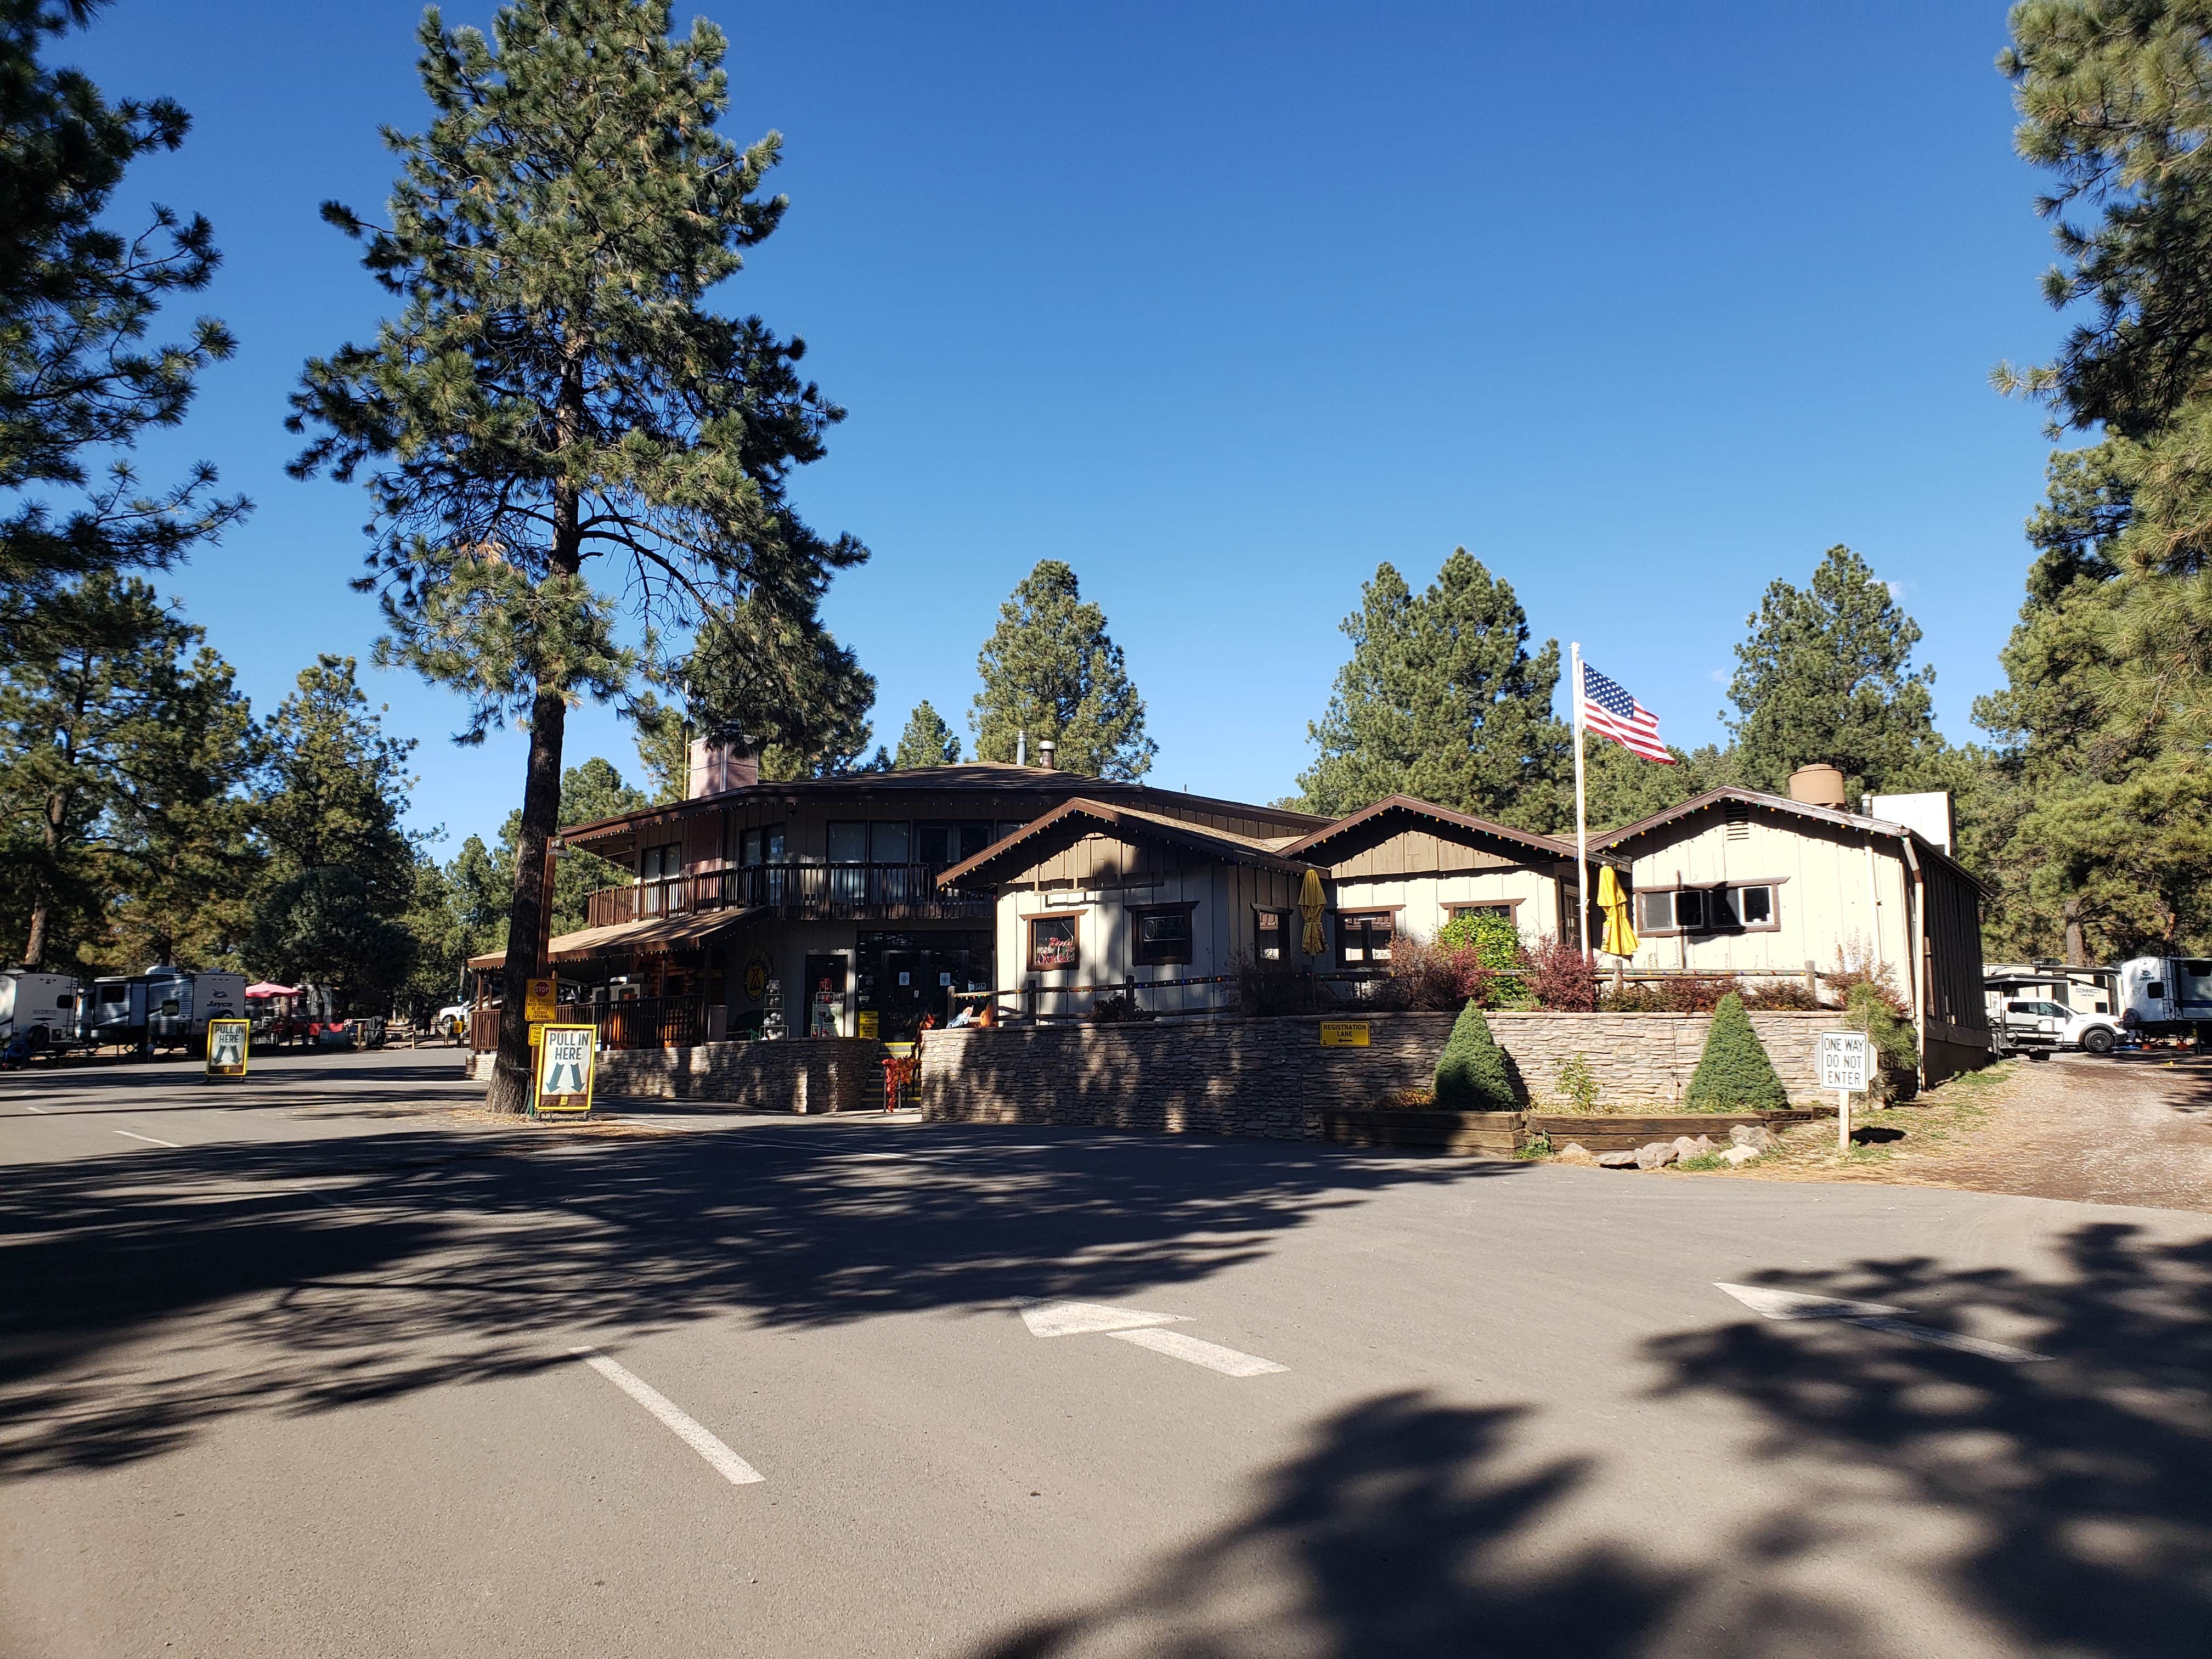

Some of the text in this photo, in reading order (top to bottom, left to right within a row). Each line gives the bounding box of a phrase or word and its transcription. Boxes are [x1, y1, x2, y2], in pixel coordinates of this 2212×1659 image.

[215, 1025, 244, 1034] PULL IN
[219, 1034, 239, 1043] HERE
[549, 1033, 589, 1046] PULL IN
[1824, 1038, 1864, 1052] ONE WAY
[555, 1047, 582, 1060] HERE
[1827, 1054, 1862, 1069] DO NOT
[1829, 1071, 1860, 1085] ENTER
